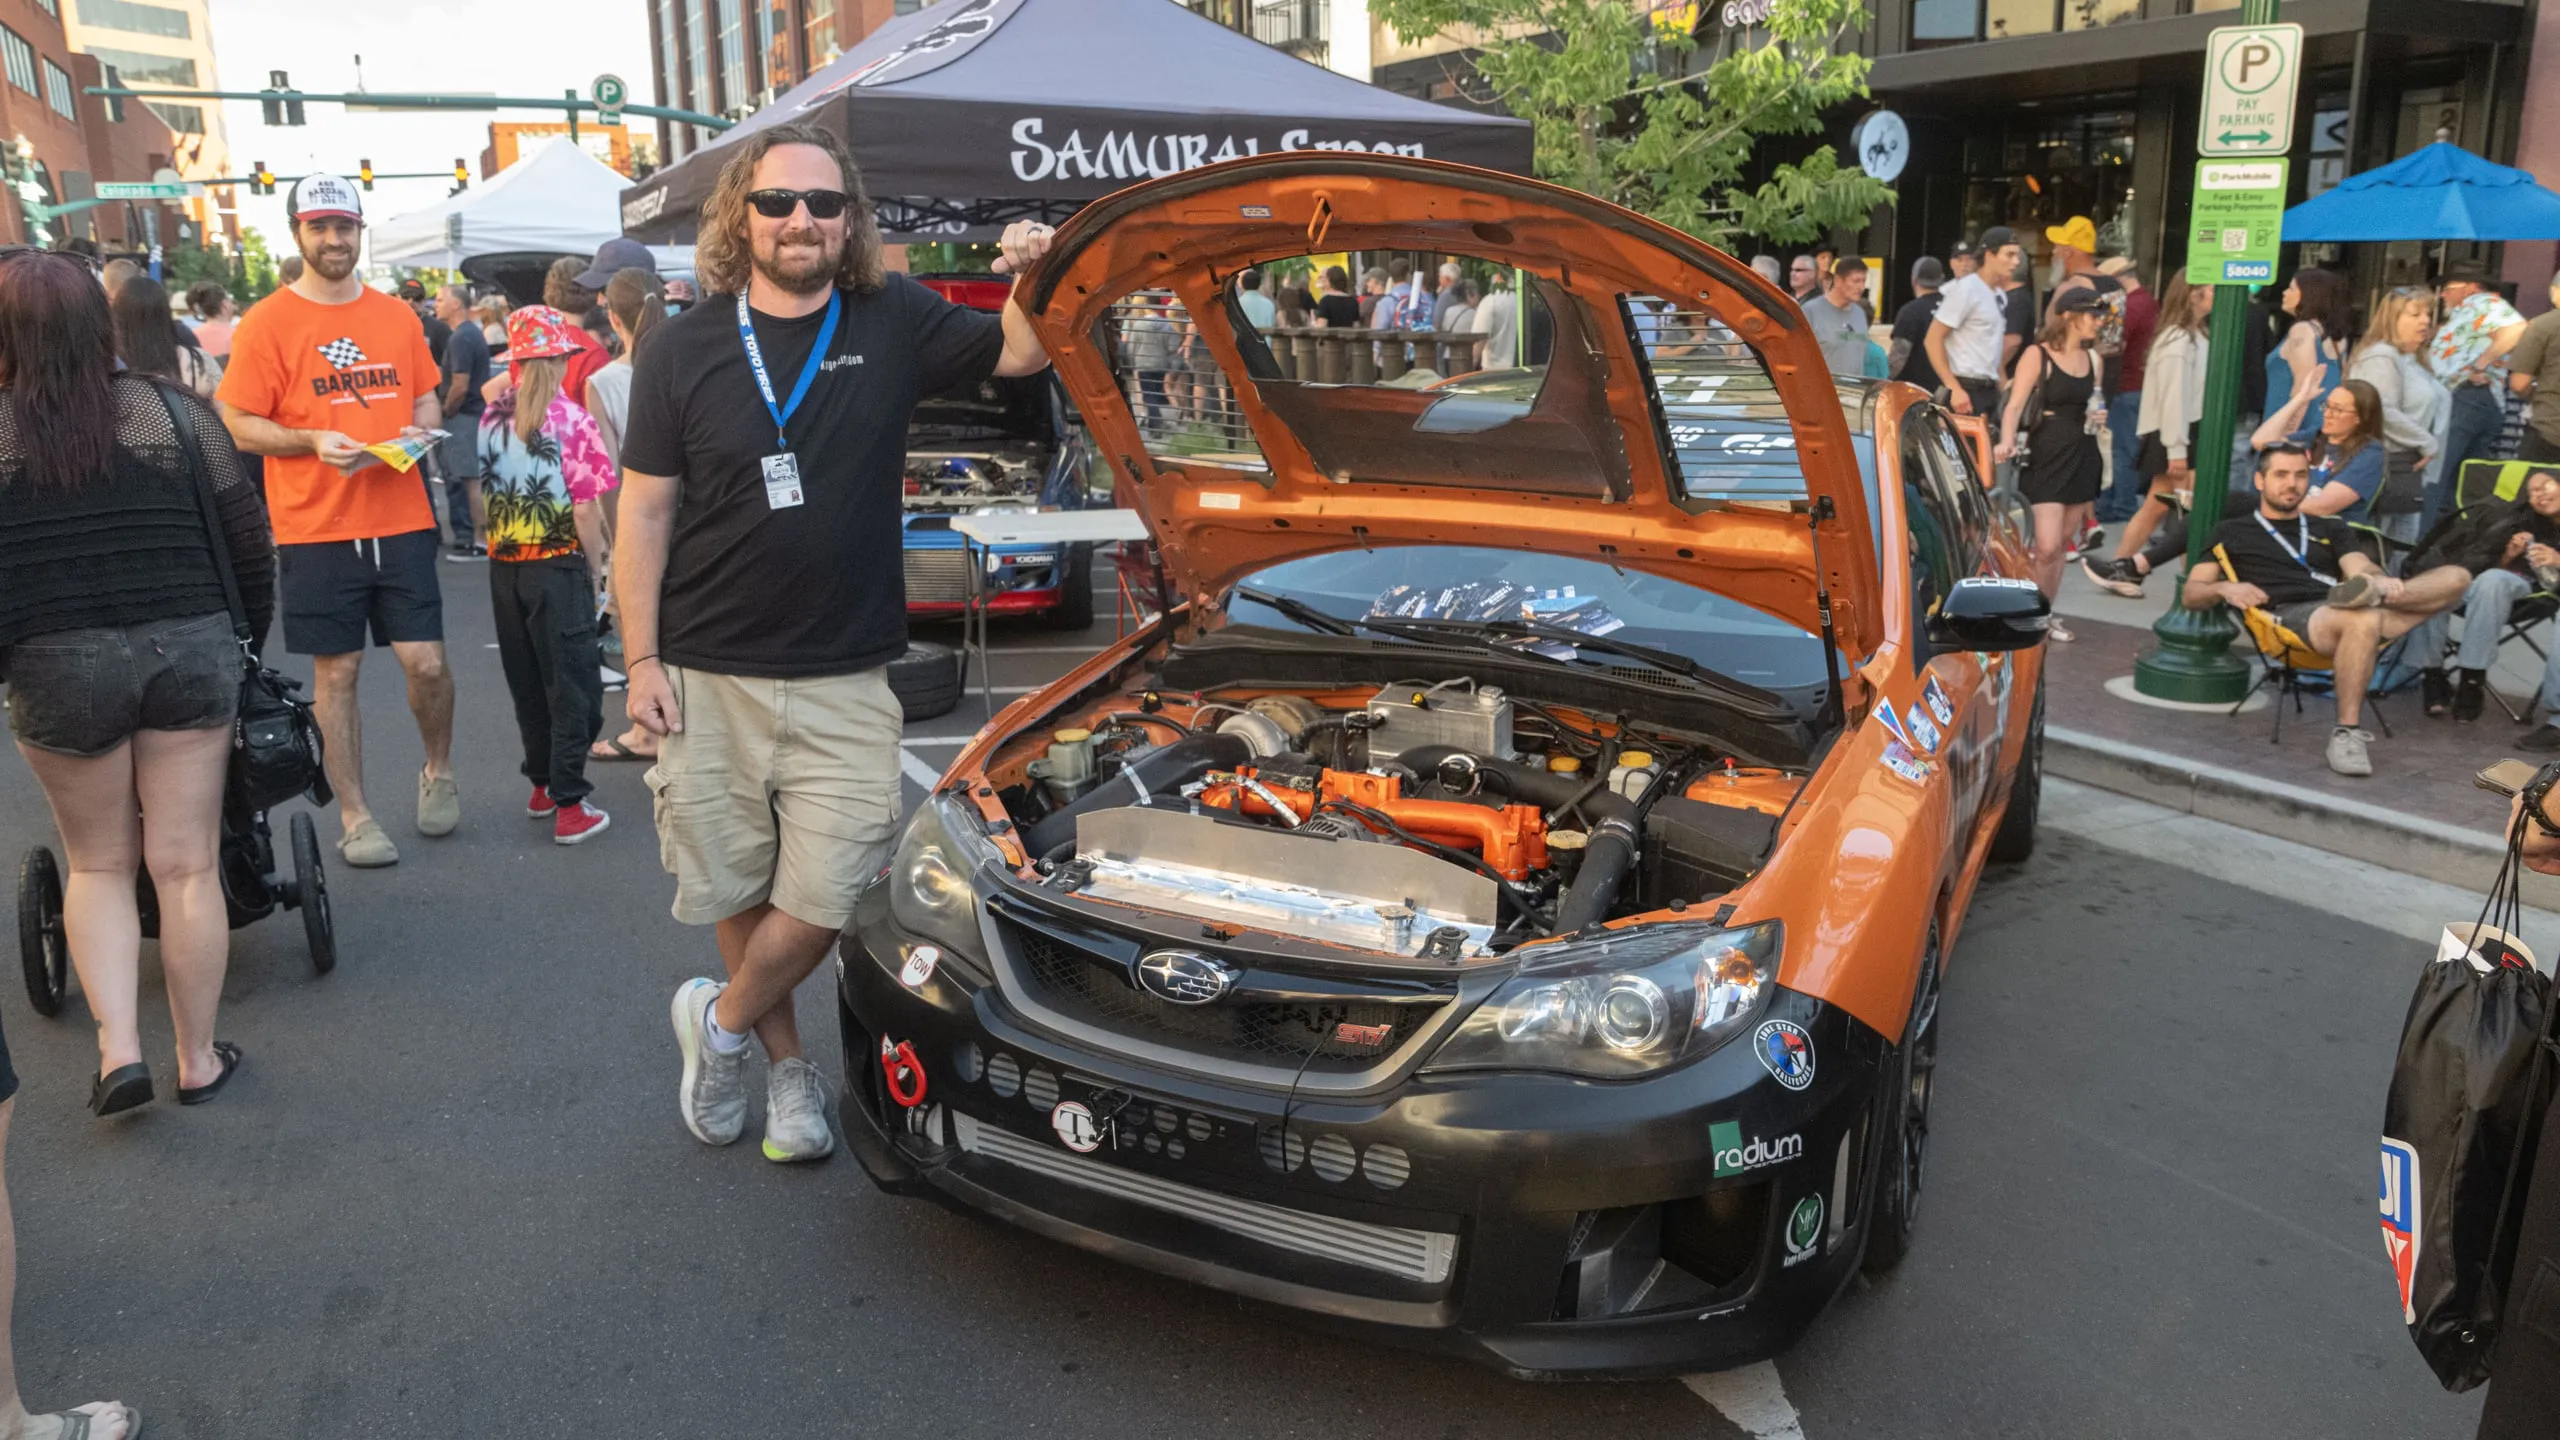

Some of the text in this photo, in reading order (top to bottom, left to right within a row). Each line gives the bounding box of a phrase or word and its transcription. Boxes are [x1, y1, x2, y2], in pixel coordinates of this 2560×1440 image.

[2239, 45, 2271, 83] P
[602, 82, 617, 101] P
[2236, 98, 2260, 111] PAY
[2218, 113, 2275, 127] PARKING
[2221, 172, 2272, 181] ParkMobile
[2213, 193, 2233, 201] Fast
[2242, 193, 2265, 202] Easy
[2199, 203, 2279, 213] Parking Payments
[745, 333, 777, 403] TOYO TIRES
[312, 367, 402, 397] BARDAHL
[910, 953, 931, 977] TOW
[1758, 1023, 1799, 1041] LONE STAR
[1774, 1063, 1813, 1087] RALLYCROSS
[1713, 1133, 1802, 1171] radium
